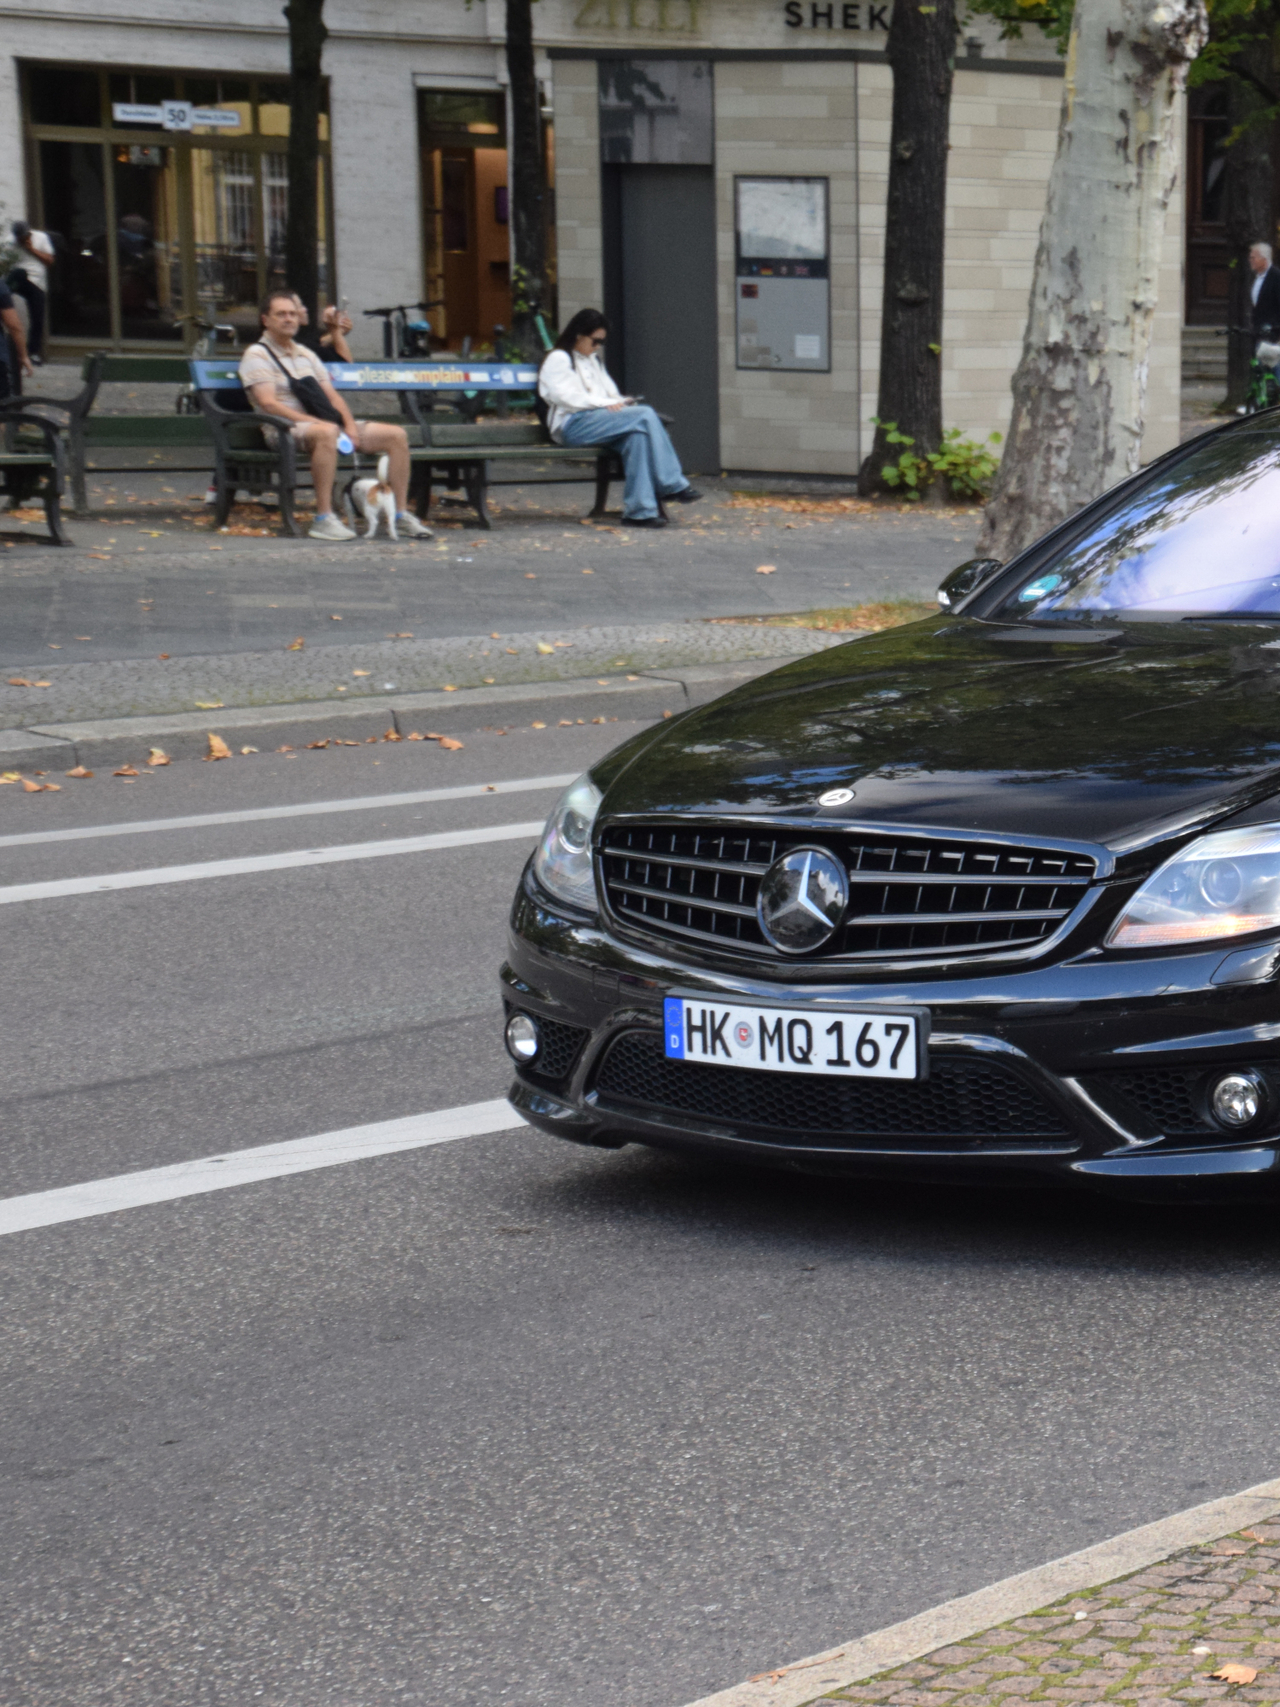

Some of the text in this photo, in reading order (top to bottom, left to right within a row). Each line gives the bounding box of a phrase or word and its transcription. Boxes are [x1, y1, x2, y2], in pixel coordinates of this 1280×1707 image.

[168, 108, 187, 122] 50
[670, 1034, 680, 1049] D
[686, 1006, 911, 1070] HK MQ 167
